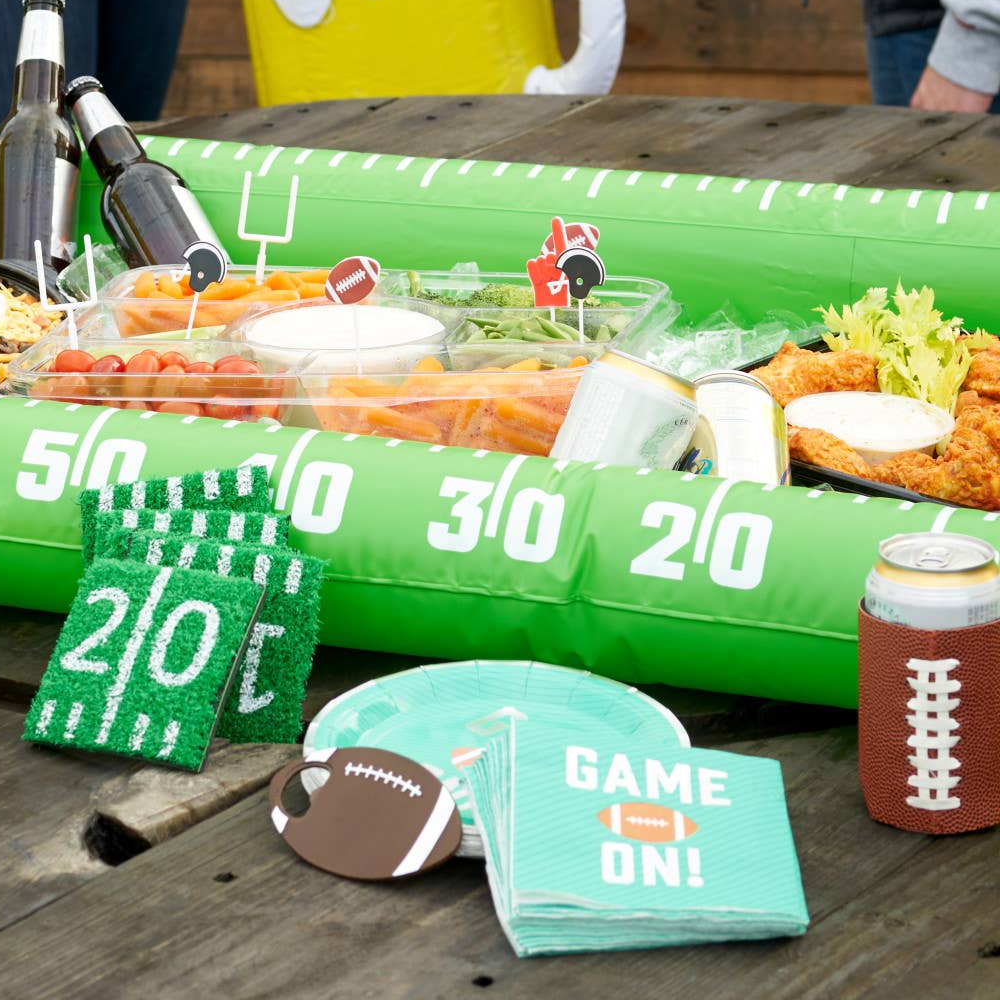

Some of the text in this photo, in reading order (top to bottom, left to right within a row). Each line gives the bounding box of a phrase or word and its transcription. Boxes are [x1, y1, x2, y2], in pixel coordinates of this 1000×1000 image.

[15, 428, 148, 502] 50
[427, 476, 566, 563] 30
[629, 501, 773, 590] 20
[60, 587, 220, 687] 20
[565, 745, 732, 807] GAME
[601, 841, 704, 888] ON!
